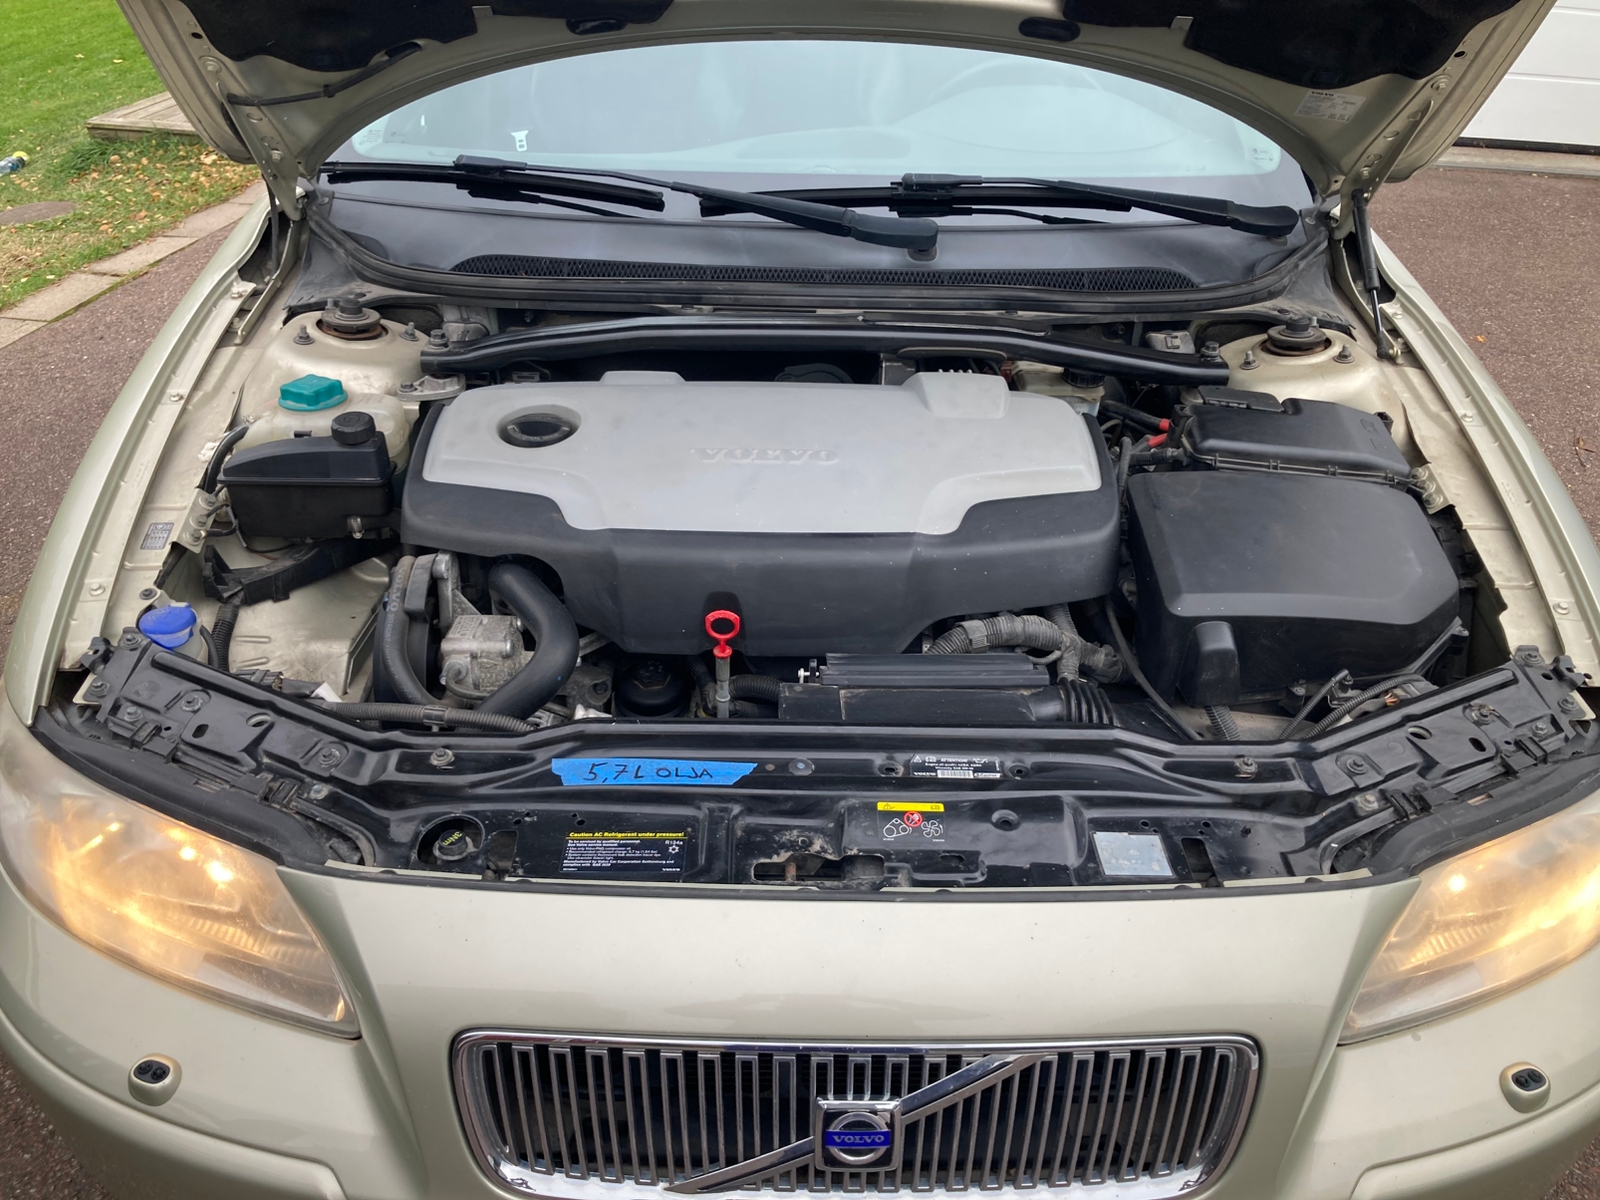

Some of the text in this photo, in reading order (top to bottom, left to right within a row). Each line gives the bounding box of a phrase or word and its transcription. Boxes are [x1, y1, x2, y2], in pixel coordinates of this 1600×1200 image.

[690, 448, 839, 465] VOLVO
[655, 767, 713, 780] OLJA
[832, 1135, 885, 1143] VOLVO
